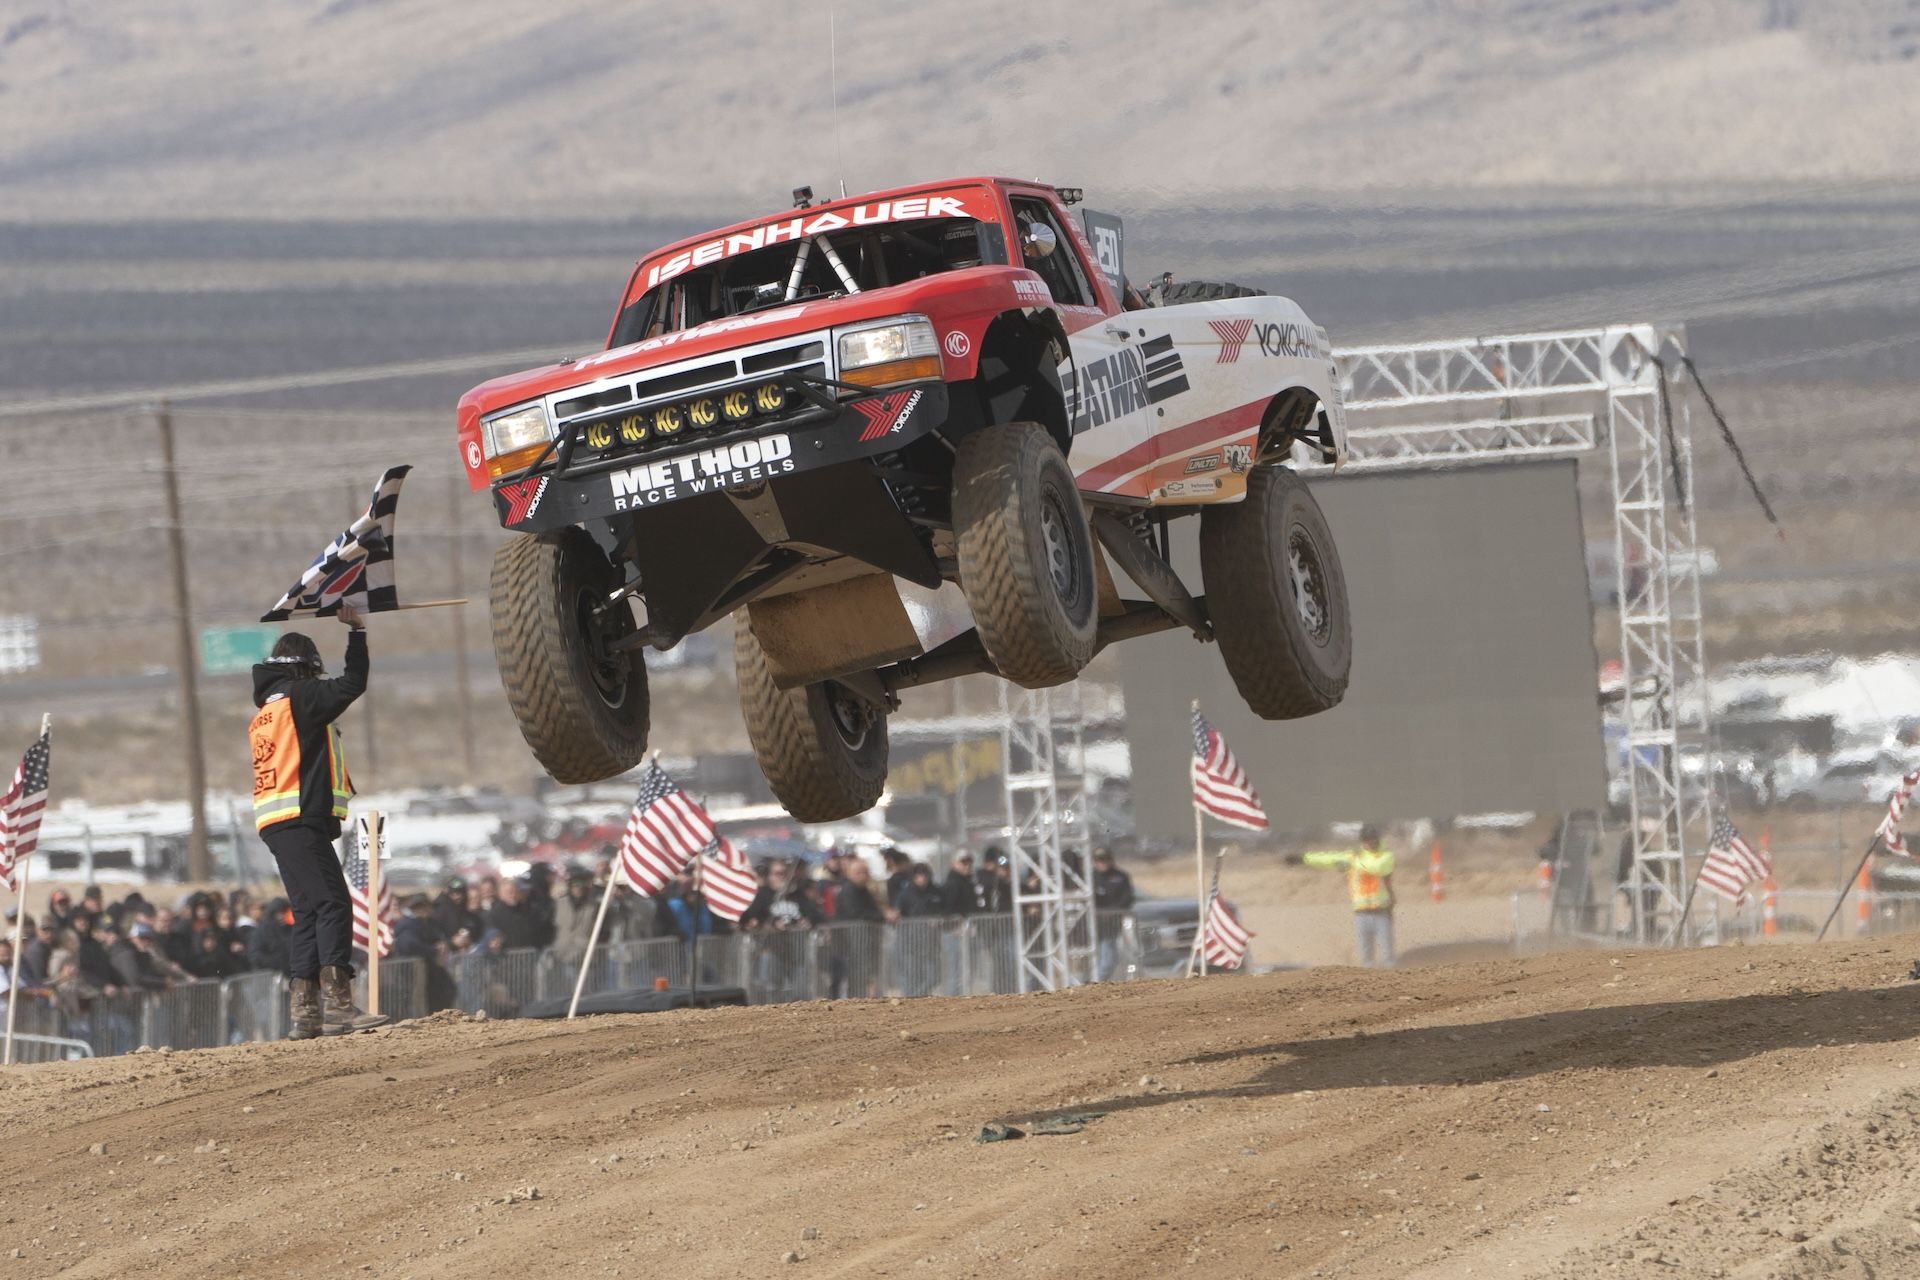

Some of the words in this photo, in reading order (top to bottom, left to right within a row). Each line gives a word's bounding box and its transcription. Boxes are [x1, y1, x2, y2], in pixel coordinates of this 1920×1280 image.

[648, 196, 971, 287] ISENHAUER
[947, 333, 967, 354] KC
[1254, 323, 1321, 360] YOKOHA
[587, 421, 611, 448] KC
[621, 414, 646, 441] KC
[655, 406, 680, 433] KC
[690, 400, 715, 425] KC
[724, 391, 749, 418] KC
[757, 384, 782, 410] KC
[891, 389, 924, 433] YOKOHAMA
[609, 433, 792, 498] METHOD
[1223, 445, 1252, 464] FOX
[525, 476, 550, 520] YOKOHAMA
[615, 486, 677, 511] RACE
[690, 459, 795, 493] WHEELS
